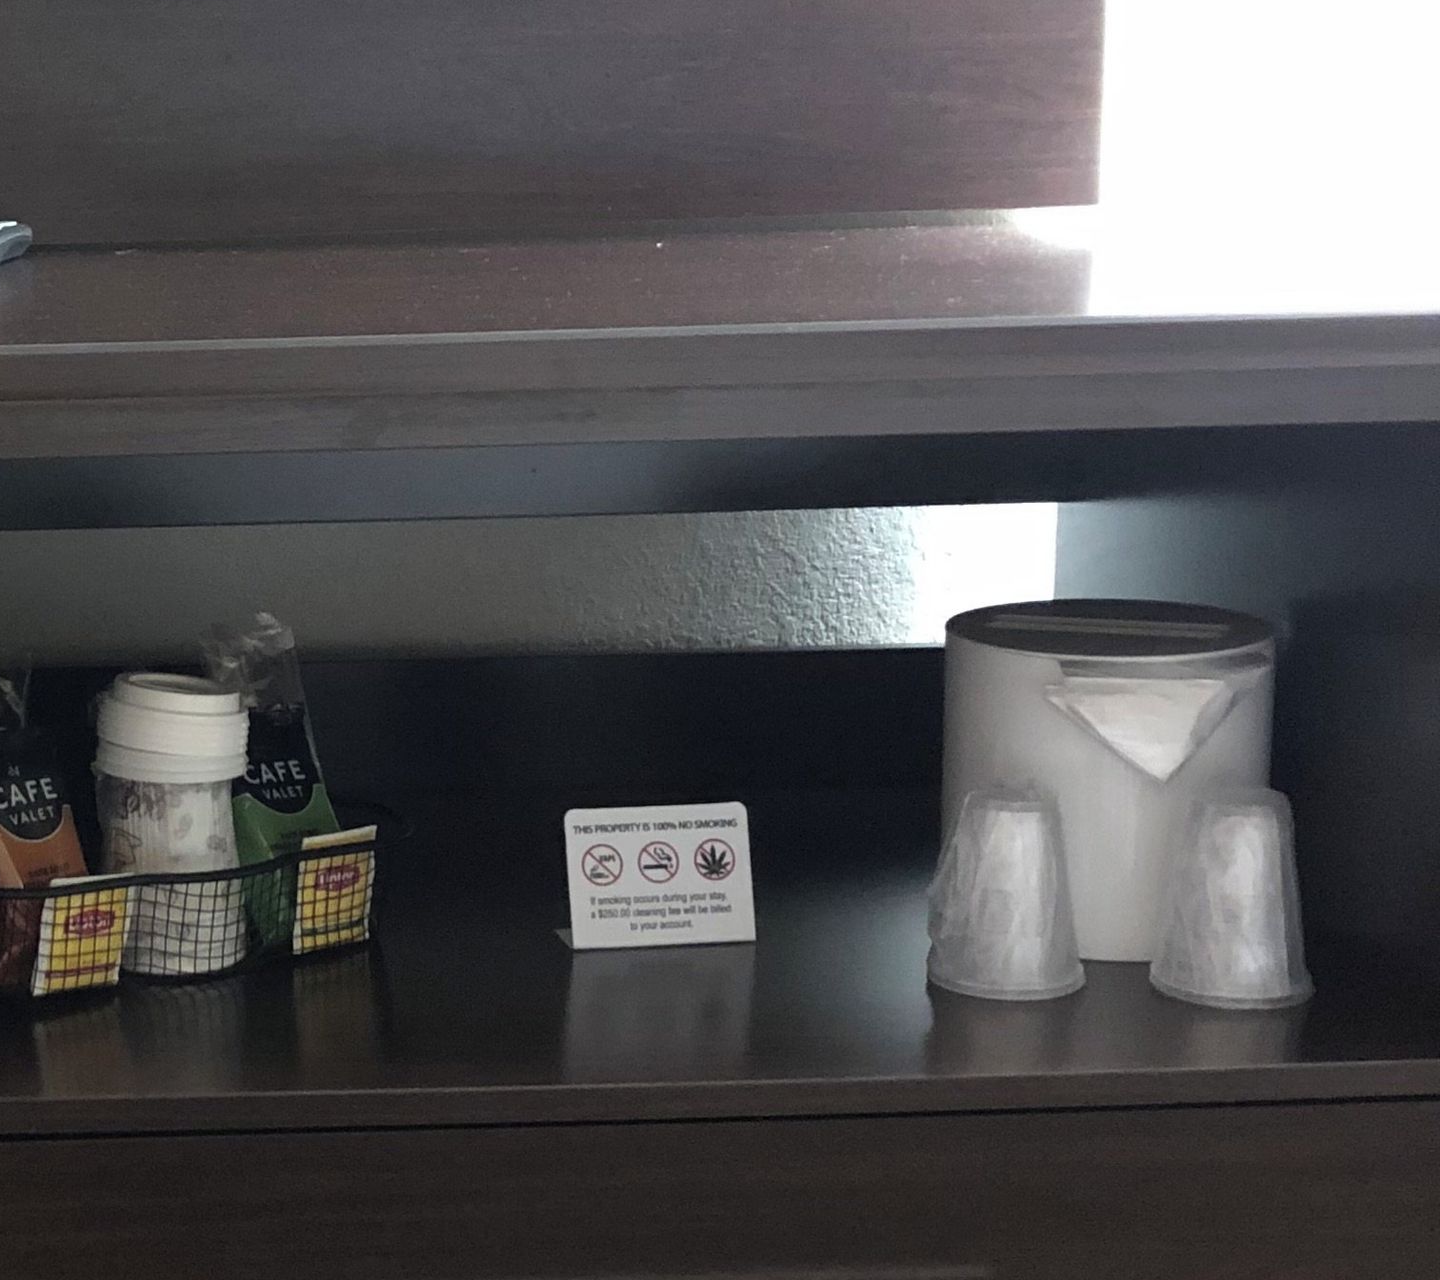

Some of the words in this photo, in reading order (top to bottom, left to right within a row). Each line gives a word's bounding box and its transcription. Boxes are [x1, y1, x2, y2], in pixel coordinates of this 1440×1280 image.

[245, 760, 306, 785] CAFE
[263, 785, 304, 800] VALET
[10, 805, 55, 826] VALET
[573, 824, 594, 835] THIS
[594, 822, 641, 833] PROPERTY
[642, 822, 651, 832] IS
[652, 821, 677, 831] 100%
[678, 820, 693, 830] NO
[693, 818, 738, 829] SMOKING
[597, 896, 632, 906] smoking
[633, 895, 660, 904] occurs
[662, 893, 688, 904] during
[689, 893, 707, 903] your
[591, 911, 596, 919] a
[632, 907, 667, 918] cleaning
[668, 906, 682, 915] fee
[683, 905, 697, 915] will
[698, 904, 709, 914] be
[710, 904, 733, 913] billed
[630, 921, 639, 931] to
[640, 921, 659, 933] your
[659, 919, 694, 930] account.
